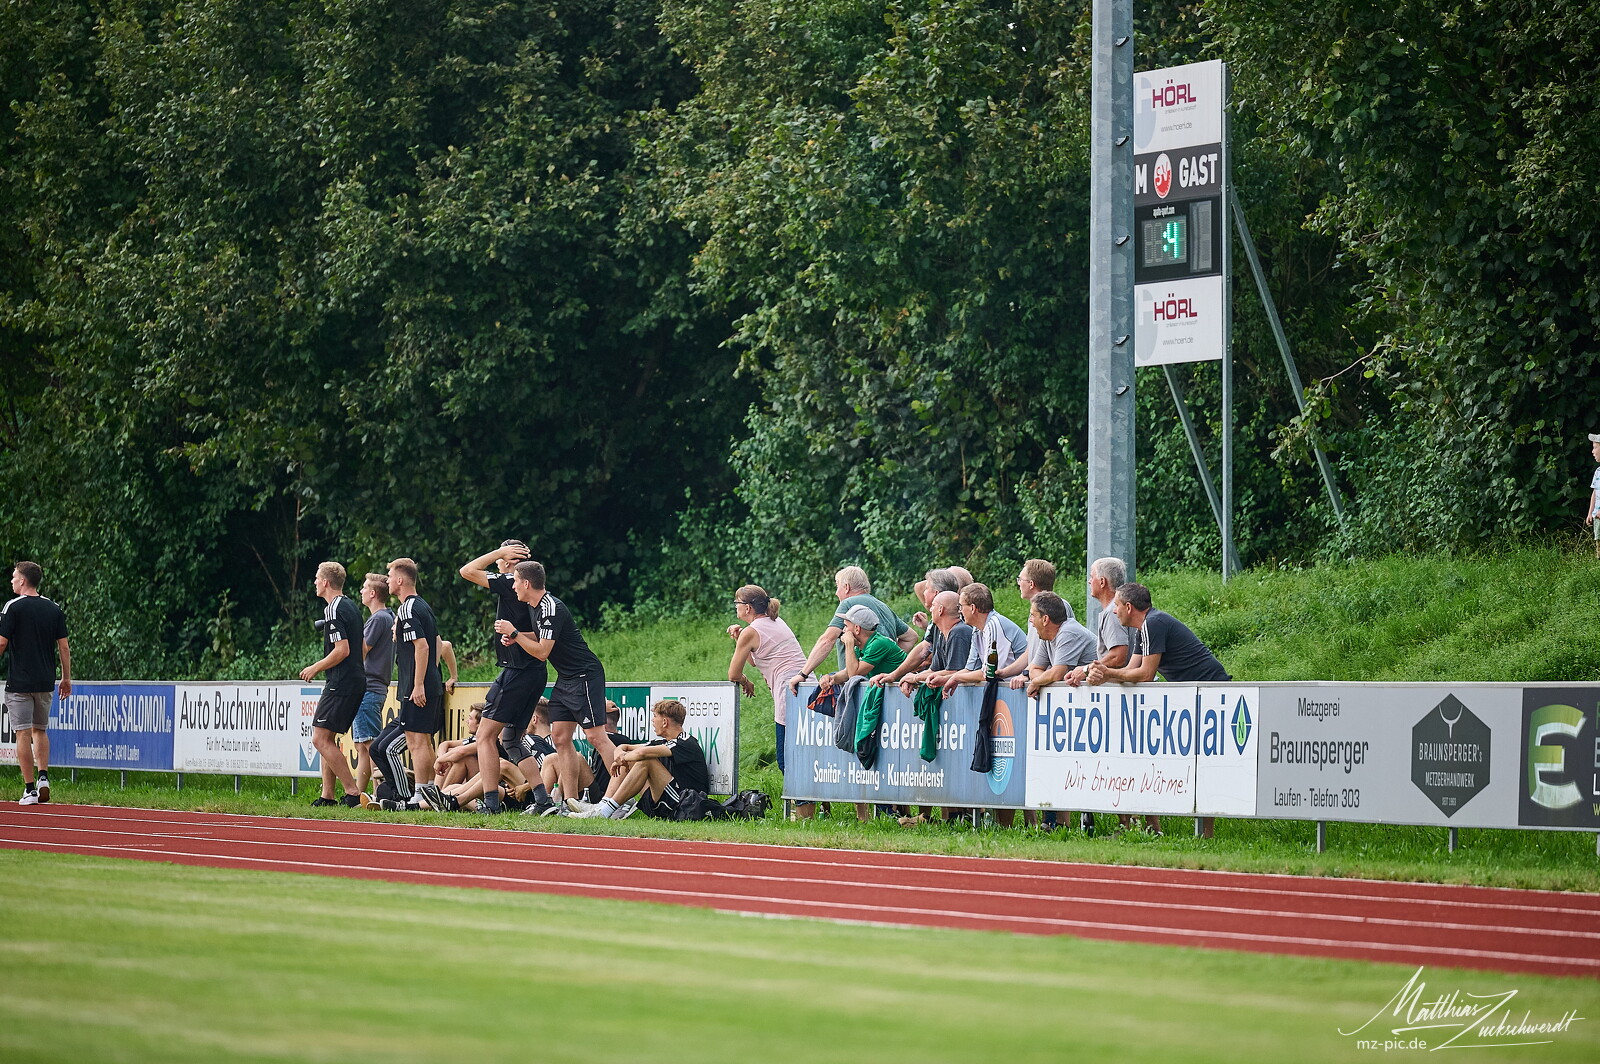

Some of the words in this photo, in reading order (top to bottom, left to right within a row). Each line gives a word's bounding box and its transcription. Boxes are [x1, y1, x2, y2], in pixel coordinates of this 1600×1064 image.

[1152, 79, 1197, 109] HÖRL
[1135, 163, 1148, 195] M
[1179, 153, 1218, 188] GAST
[1154, 293, 1198, 321] HÖRL
[179, 690, 211, 730] Auto
[214, 688, 291, 731] Buchwinkler
[301, 701, 318, 716] BOSC
[1297, 697, 1340, 722] Metzgerei
[300, 722, 315, 737] Serv
[795, 706, 834, 747] Mich
[1034, 692, 1110, 754] Heizöl
[1120, 693, 1225, 756] Nickolai
[221, 737, 232, 752] Auto
[1270, 731, 1369, 774] Braunsperger
[813, 760, 841, 784] Sanitär
[848, 762, 880, 791] Heizung
[887, 763, 945, 788] Kundendienst
[1064, 761, 1087, 791] Wir
[1091, 760, 1135, 807] bringen
[1140, 763, 1191, 795] Wärme!
[1425, 771, 1475, 788] METZGERHANDWERK
[1274, 787, 1302, 807] Laufen
[1309, 788, 1339, 808] Telefon
[1341, 788, 1360, 808] 303
